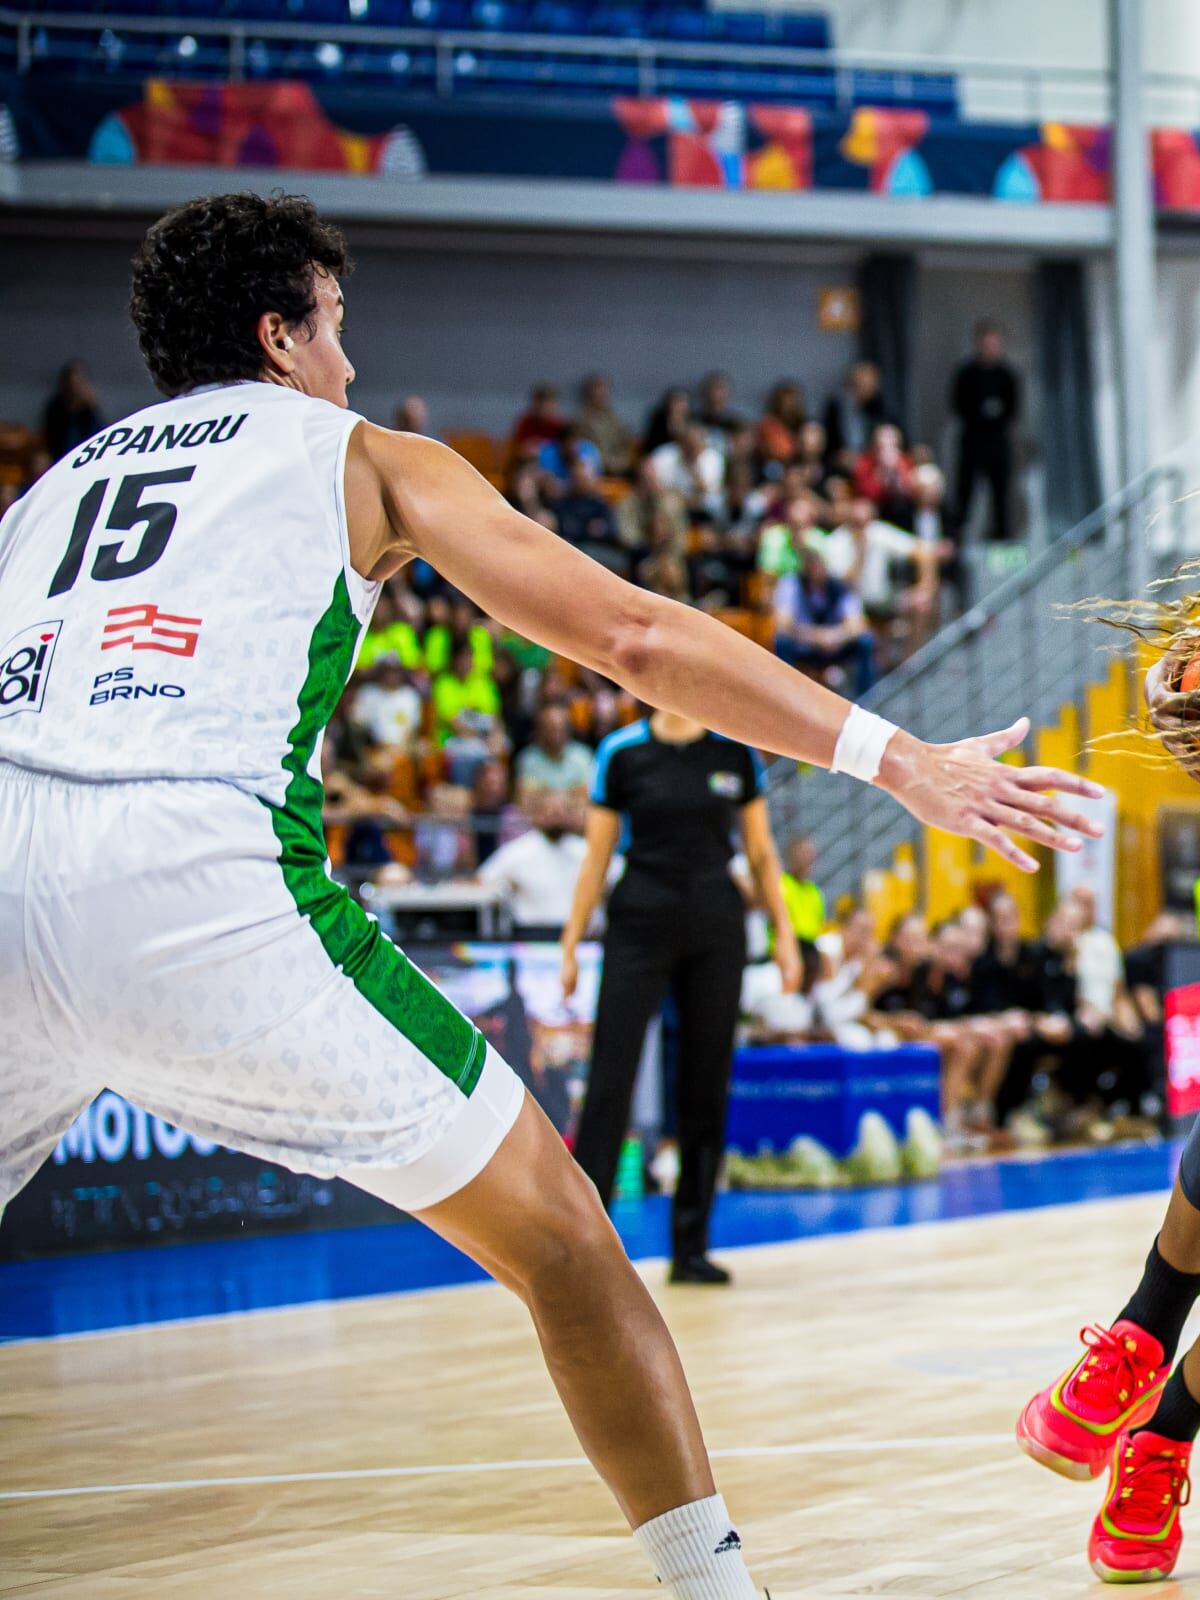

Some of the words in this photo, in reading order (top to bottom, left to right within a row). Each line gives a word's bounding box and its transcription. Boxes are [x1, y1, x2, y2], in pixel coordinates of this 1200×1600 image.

[72, 413, 249, 469] SPANOU
[47, 465, 197, 599] 15
[89, 684, 186, 706] BRNO
[93, 667, 134, 688] PS
